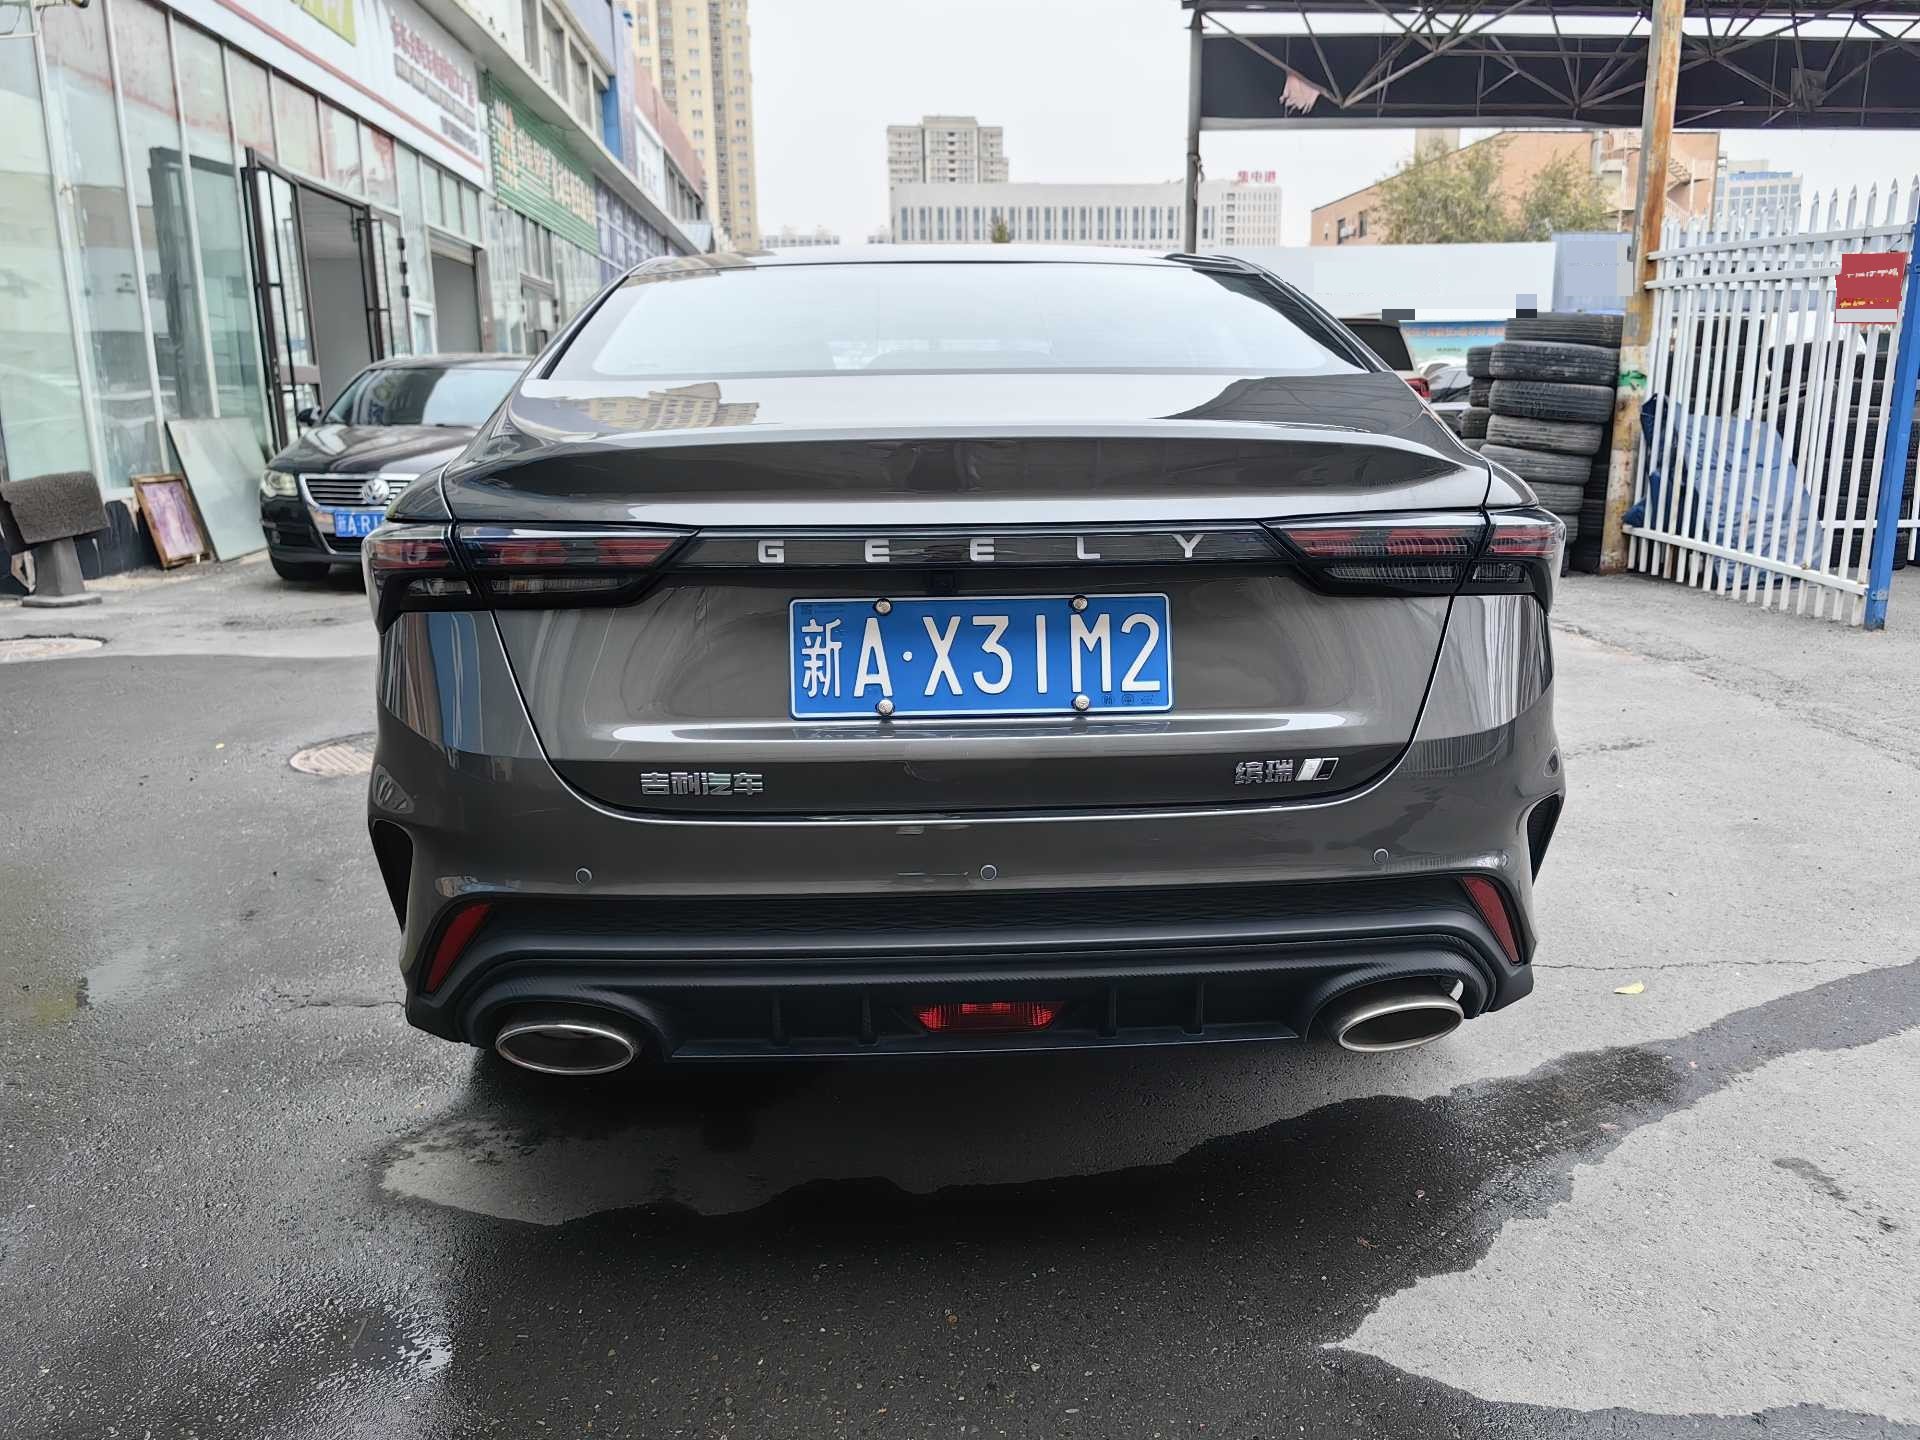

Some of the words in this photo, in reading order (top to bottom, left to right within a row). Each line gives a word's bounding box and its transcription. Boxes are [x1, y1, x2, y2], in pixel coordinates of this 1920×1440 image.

[757, 533, 1205, 564] GEELY
[801, 613, 1161, 698] 新A·X31M2
[640, 772, 763, 795] 吉利汽车
[1234, 759, 1294, 785] 缤瑞
